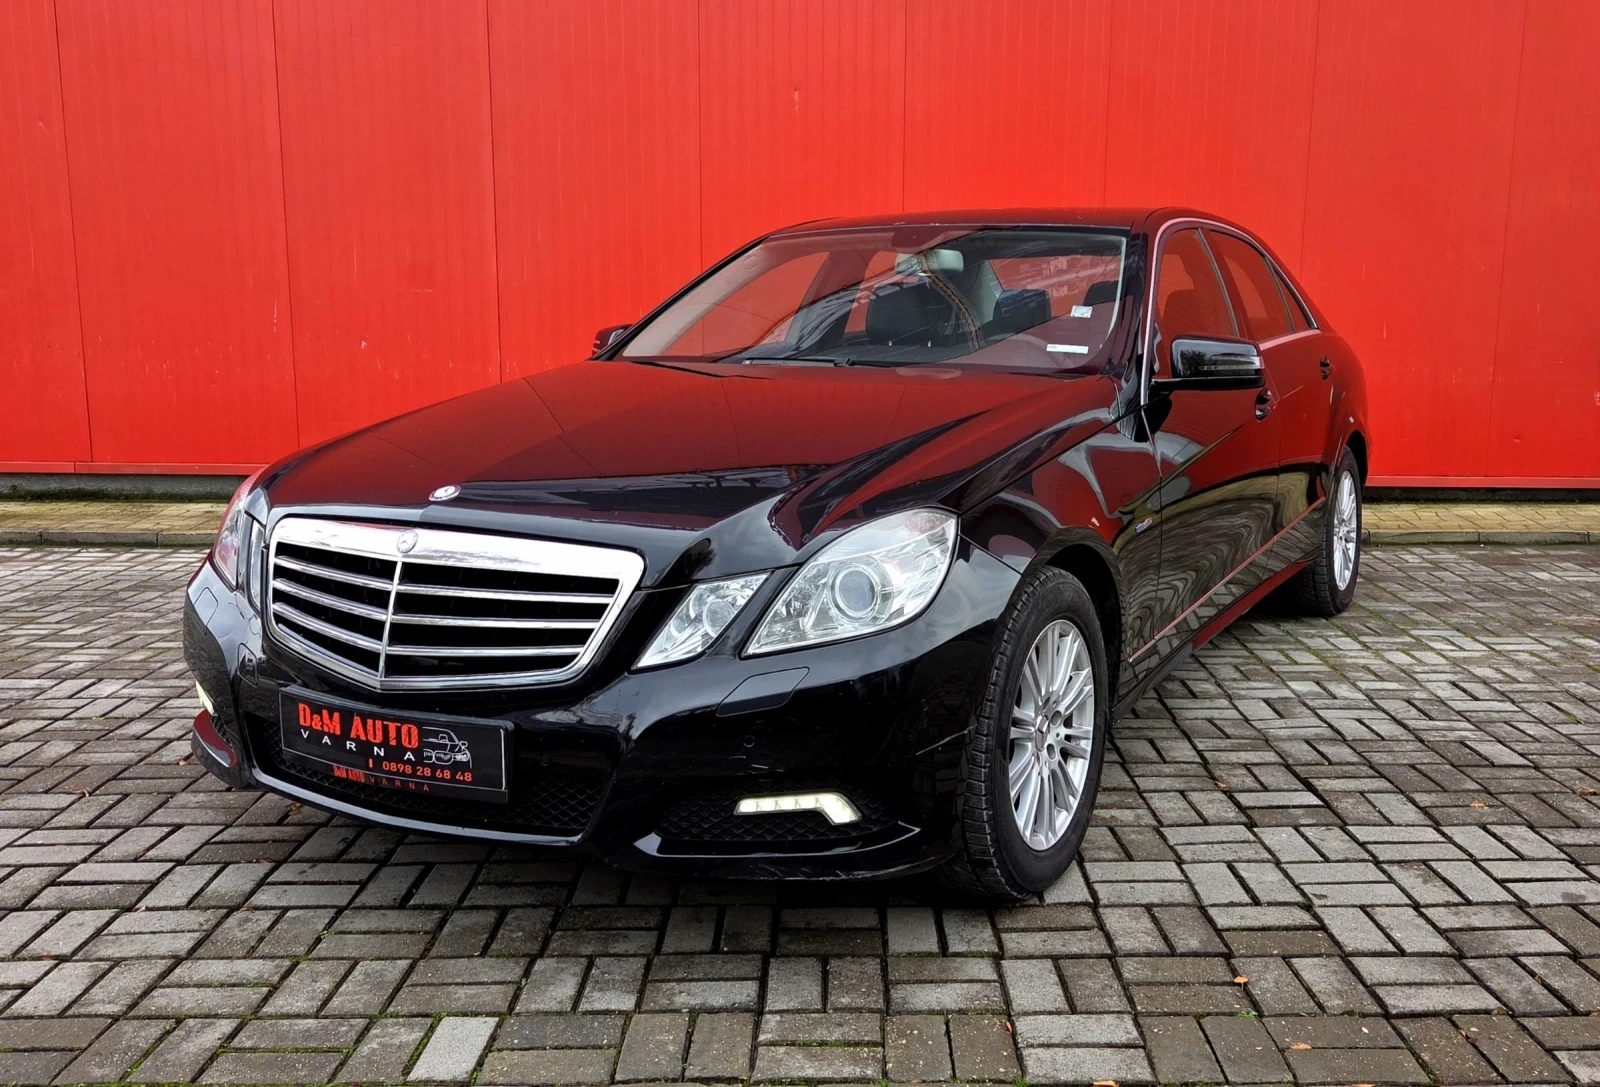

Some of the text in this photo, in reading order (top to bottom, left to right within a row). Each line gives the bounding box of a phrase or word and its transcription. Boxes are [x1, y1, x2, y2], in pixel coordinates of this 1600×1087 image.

[298, 702, 419, 749] D&M AUTO
[300, 728, 416, 761] VARNA
[348, 768, 366, 783] AUTO
[369, 774, 430, 792] VARNA
[382, 761, 472, 782] 0898 28 68 48
